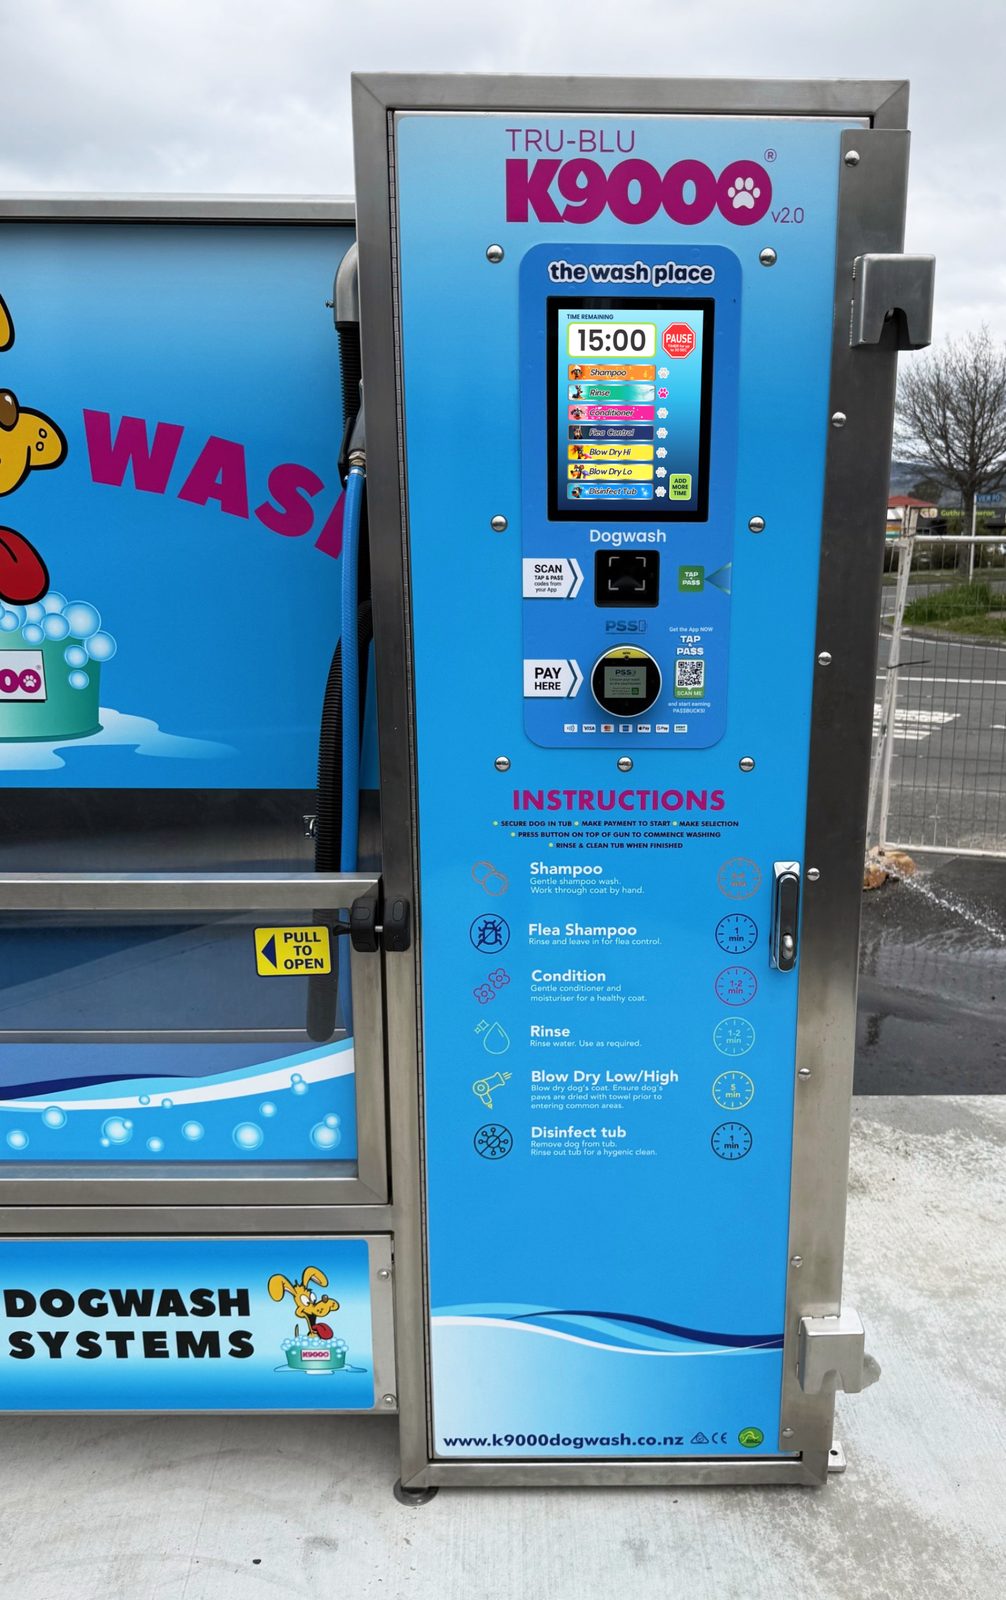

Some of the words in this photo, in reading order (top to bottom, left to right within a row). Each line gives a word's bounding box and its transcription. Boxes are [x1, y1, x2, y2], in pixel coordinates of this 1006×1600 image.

[505, 129, 635, 152] TRU-BLU
[506, 158, 772, 226] K9000
[771, 207, 804, 224] v2.0
[549, 261, 587, 284] the
[589, 261, 651, 284] wash
[652, 262, 715, 287] place
[578, 329, 645, 351] 15:00
[666, 334, 692, 343] PAUSE
[590, 368, 626, 377] Shampoo
[590, 389, 610, 397] Rinse
[589, 448, 608, 456] Blow
[608, 448, 622, 457] Dry
[623, 448, 631, 456] Hi
[589, 468, 607, 476] Blow
[608, 468, 622, 478] Dry
[589, 487, 621, 495] Disinfect
[622, 487, 637, 495] Tub
[589, 529, 667, 547] Dogwash
[534, 564, 562, 573] SCAN
[680, 635, 701, 643] TAP
[534, 667, 562, 679] PAY
[534, 681, 561, 691] HERE
[513, 789, 725, 811] INSTRUCTIONS
[529, 862, 602, 877] Shampoo
[530, 877, 557, 885] Gentle
[559, 878, 596, 888] shampoo
[531, 886, 552, 894] Work
[555, 886, 587, 896] through
[610, 886, 620, 896] by
[622, 886, 644, 894] hand.
[529, 923, 560, 935] Flea
[566, 923, 637, 938] Shampoo
[284, 932, 321, 943] PULL
[529, 937, 550, 945] Rinse
[552, 937, 568, 945] and
[569, 937, 590, 945] leave
[592, 937, 600, 945] in
[601, 937, 613, 945] for
[615, 937, 630, 945] flea
[632, 937, 661, 945] control.
[293, 945, 312, 956] TO
[284, 959, 324, 969] OPEN
[531, 969, 606, 982] Condition
[728, 987, 743, 995] min
[597, 995, 625, 1004] healthy
[530, 1025, 570, 1037] Rinse
[606, 1040, 642, 1049] required.
[531, 1071, 568, 1082] Blow
[574, 1071, 600, 1085] Dry
[606, 1070, 678, 1085] Low/High
[552, 1085, 565, 1093] dry
[632, 1093, 651, 1102] prior
[531, 1102, 563, 1110] entering
[531, 1126, 596, 1138] Disinfect
[601, 1126, 627, 1138] tub
[564, 1140, 580, 1149] dog
[531, 1148, 551, 1156] Rinse
[568, 1148, 582, 1156] tub
[584, 1148, 595, 1156] for
[604, 1148, 633, 1158] hygenic
[635, 1148, 657, 1156] clean.
[3, 1288, 250, 1318] DOGWASH
[8, 1330, 255, 1359] SYSTEMS
[443, 1433, 684, 1448] www.k9000dogwash.co.nz
